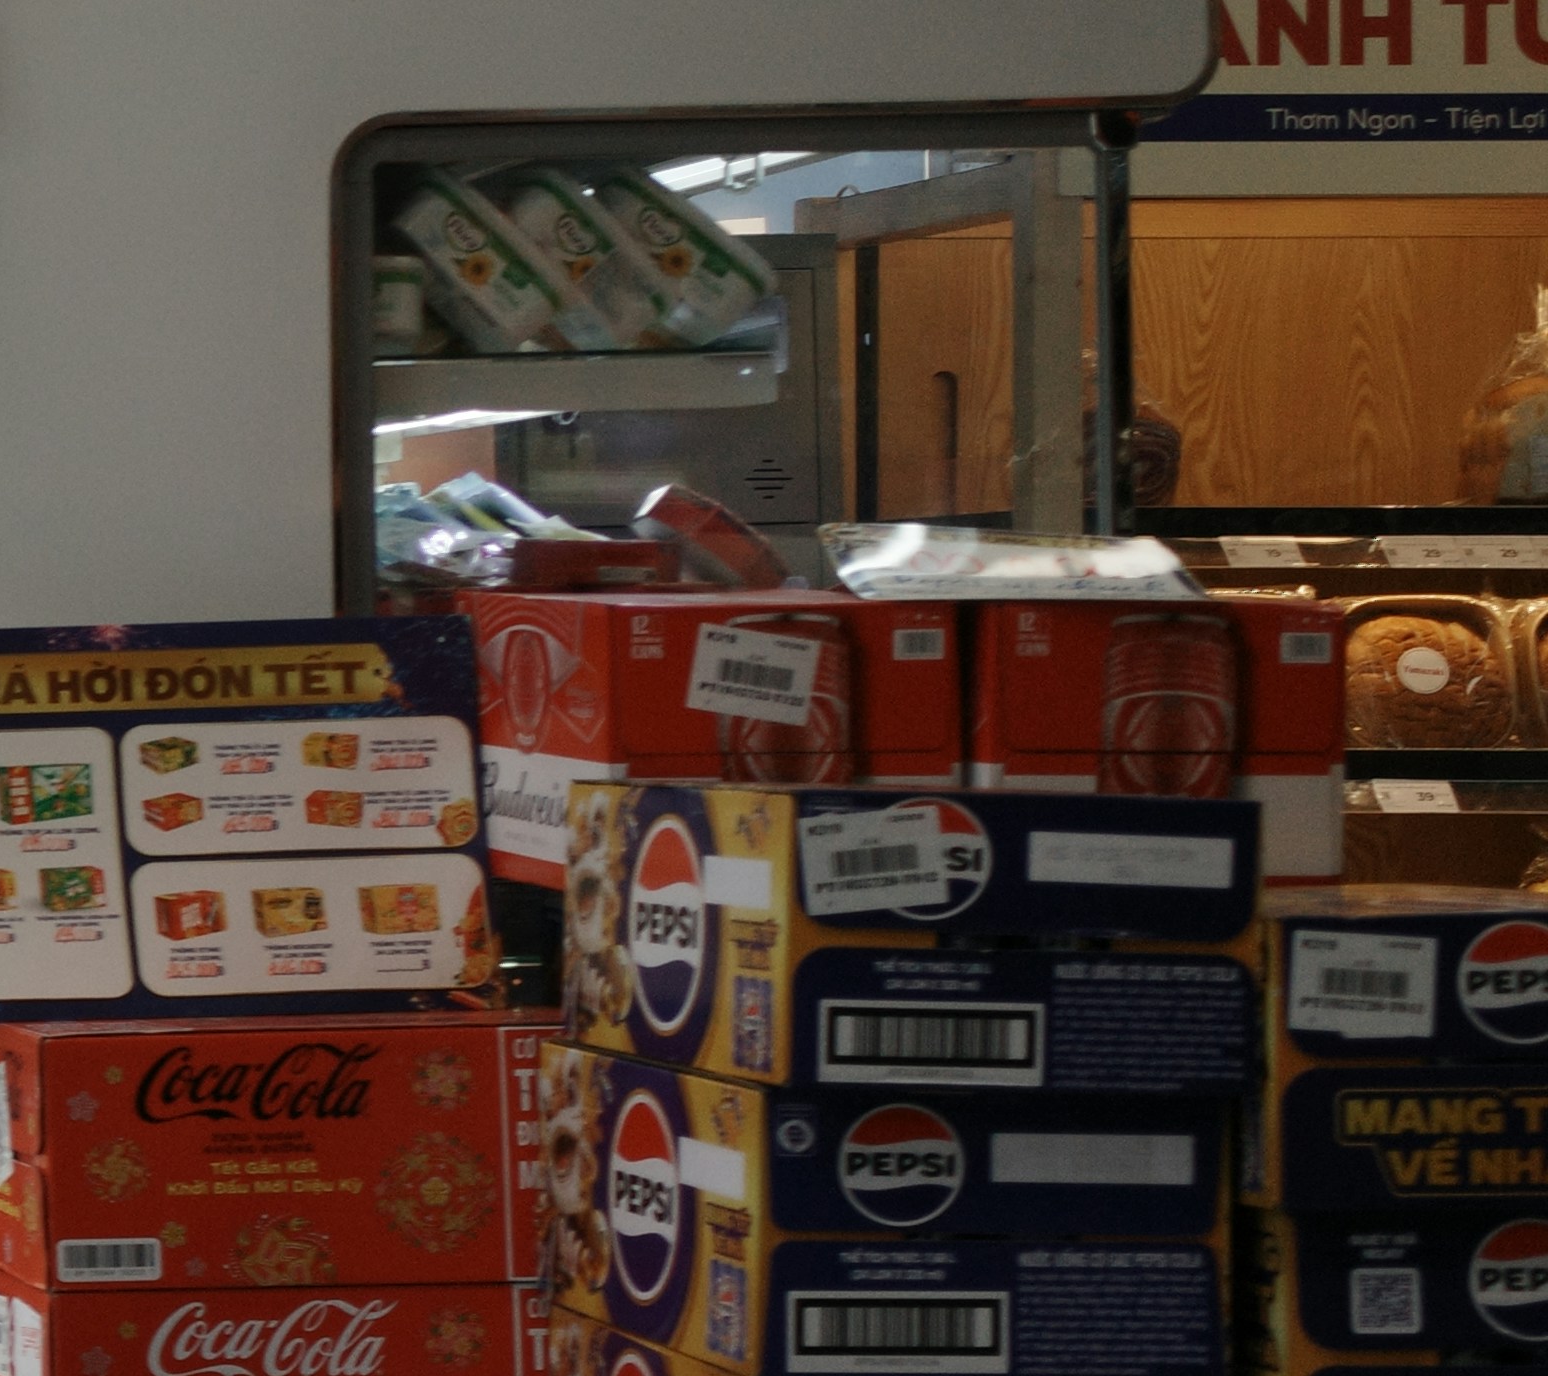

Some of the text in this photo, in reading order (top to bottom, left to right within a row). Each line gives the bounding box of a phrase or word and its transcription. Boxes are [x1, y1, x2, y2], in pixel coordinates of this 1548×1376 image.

[1267, 108, 1545, 135] Thơm Ngon Tiện Lợi
[46, 660, 133, 704] HỜI
[143, 657, 253, 700] ĐÓN
[263, 649, 366, 697] TẾT
[638, 903, 699, 949] PEPSI
[136, 1042, 391, 1122] Coca-Cola
[846, 1152, 956, 1175] PEPSI
